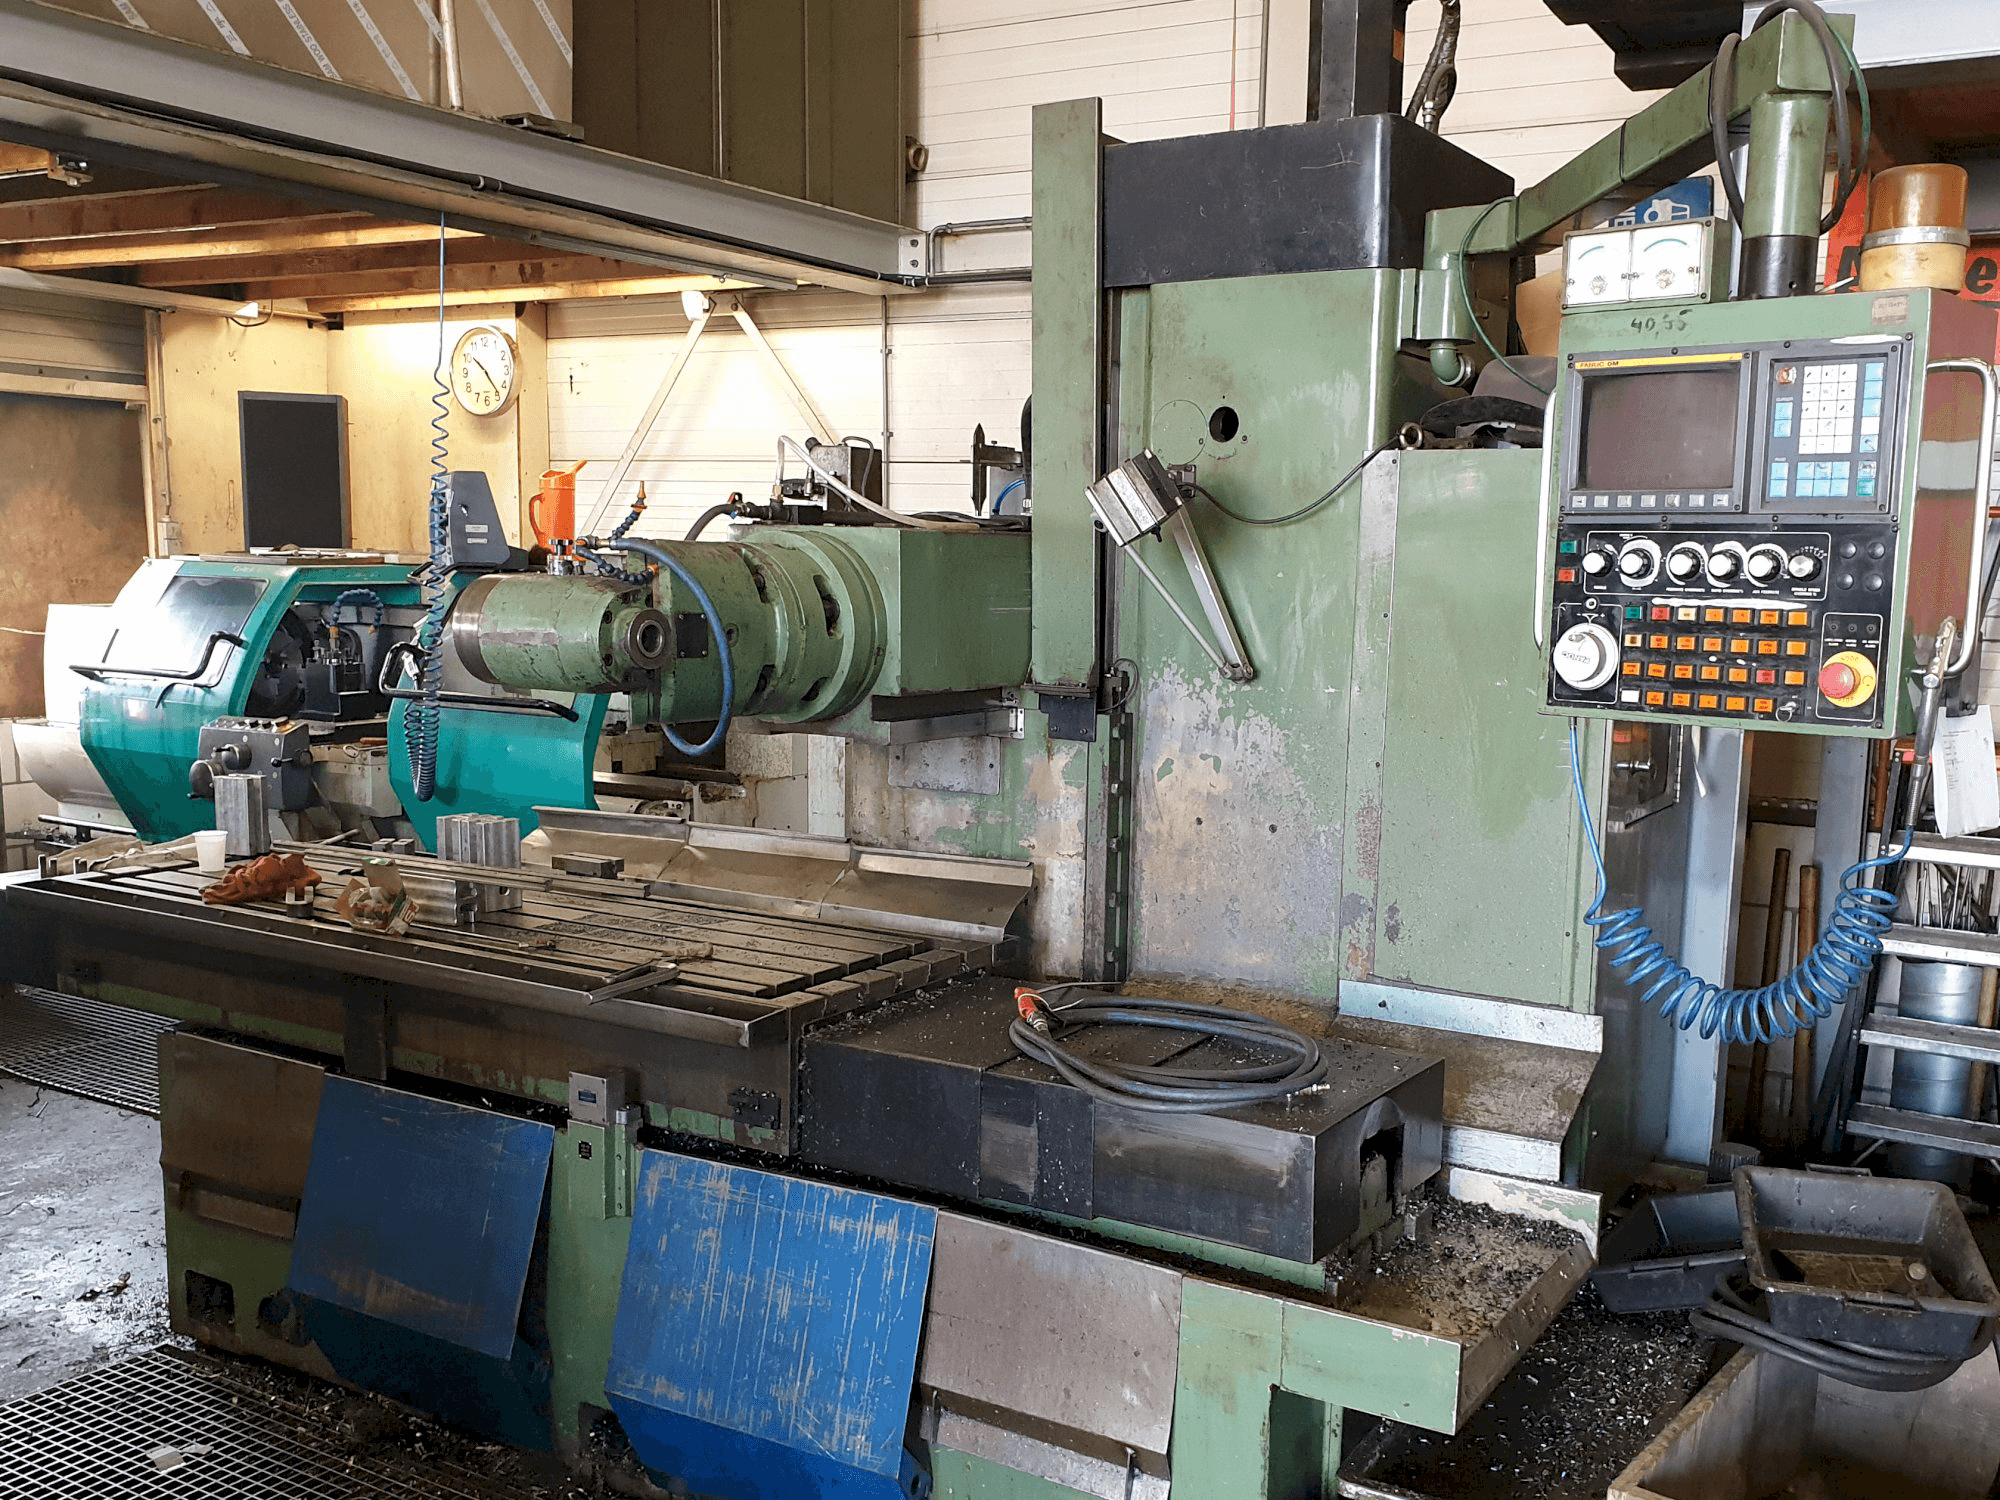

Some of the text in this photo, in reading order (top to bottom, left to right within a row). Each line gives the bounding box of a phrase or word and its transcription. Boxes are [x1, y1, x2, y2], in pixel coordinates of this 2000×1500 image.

[471, 341, 477, 351] 11
[480, 336, 489, 347] 12
[463, 353, 472, 363] 10
[500, 350, 506, 361] 2
[463, 367, 469, 378] 9
[504, 365, 510, 376] 3
[466, 382, 472, 393] 8
[501, 380, 507, 388] 4
[474, 392, 480, 403] 7
[484, 395, 490, 407] 6
[495, 391, 501, 401] 5
